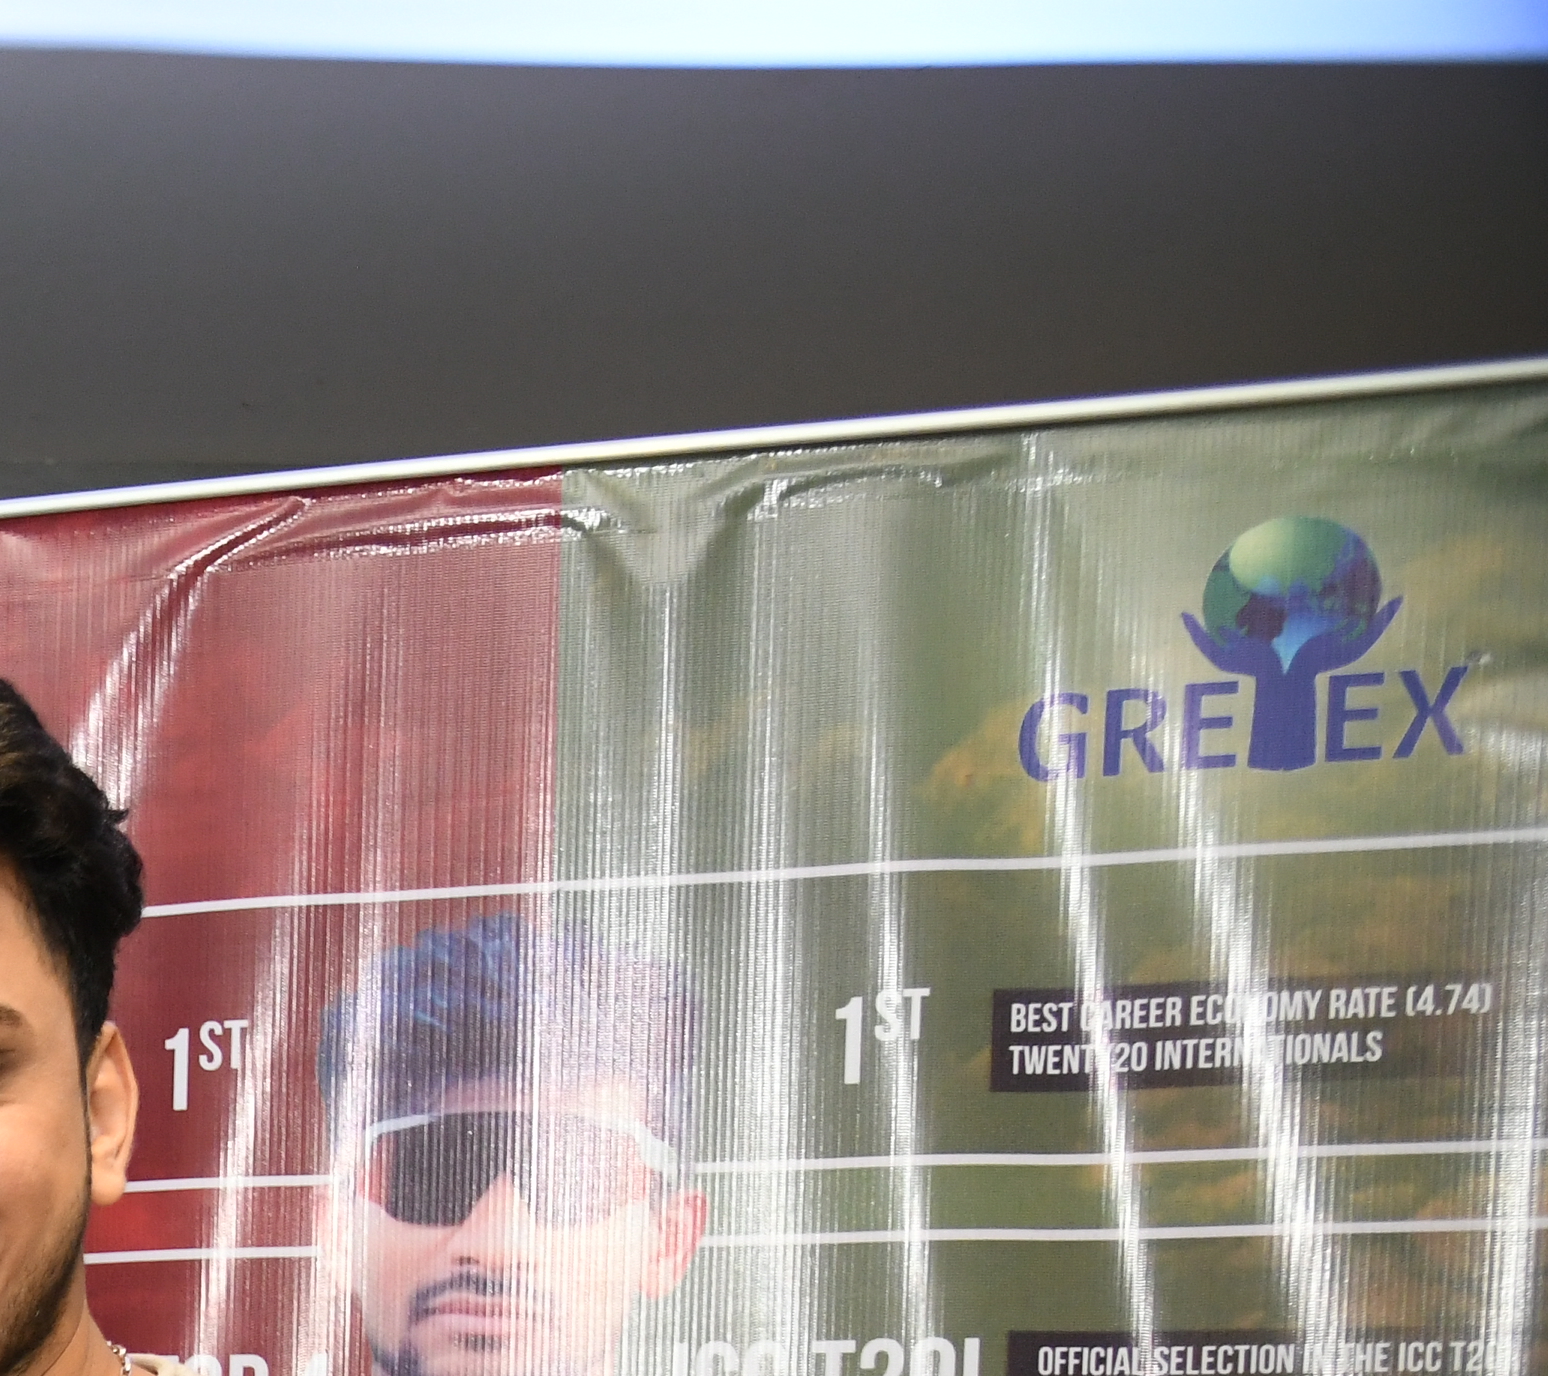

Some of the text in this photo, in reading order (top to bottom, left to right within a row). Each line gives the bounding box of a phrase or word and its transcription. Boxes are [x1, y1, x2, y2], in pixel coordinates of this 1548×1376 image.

[1011, 983, 1493, 1033] BEST CAREER ECOOMY RATE (4.74)
[835, 986, 931, 1085] 1ST
[1009, 1030, 1383, 1075] TWENT20 INTERNTIONALS
[164, 1018, 249, 1111] 1ST
[1037, 1346, 1145, 1376] OFFICIAL
[1153, 1344, 1294, 1376] SELECTION
[1398, 1341, 1442, 1372] ICC
